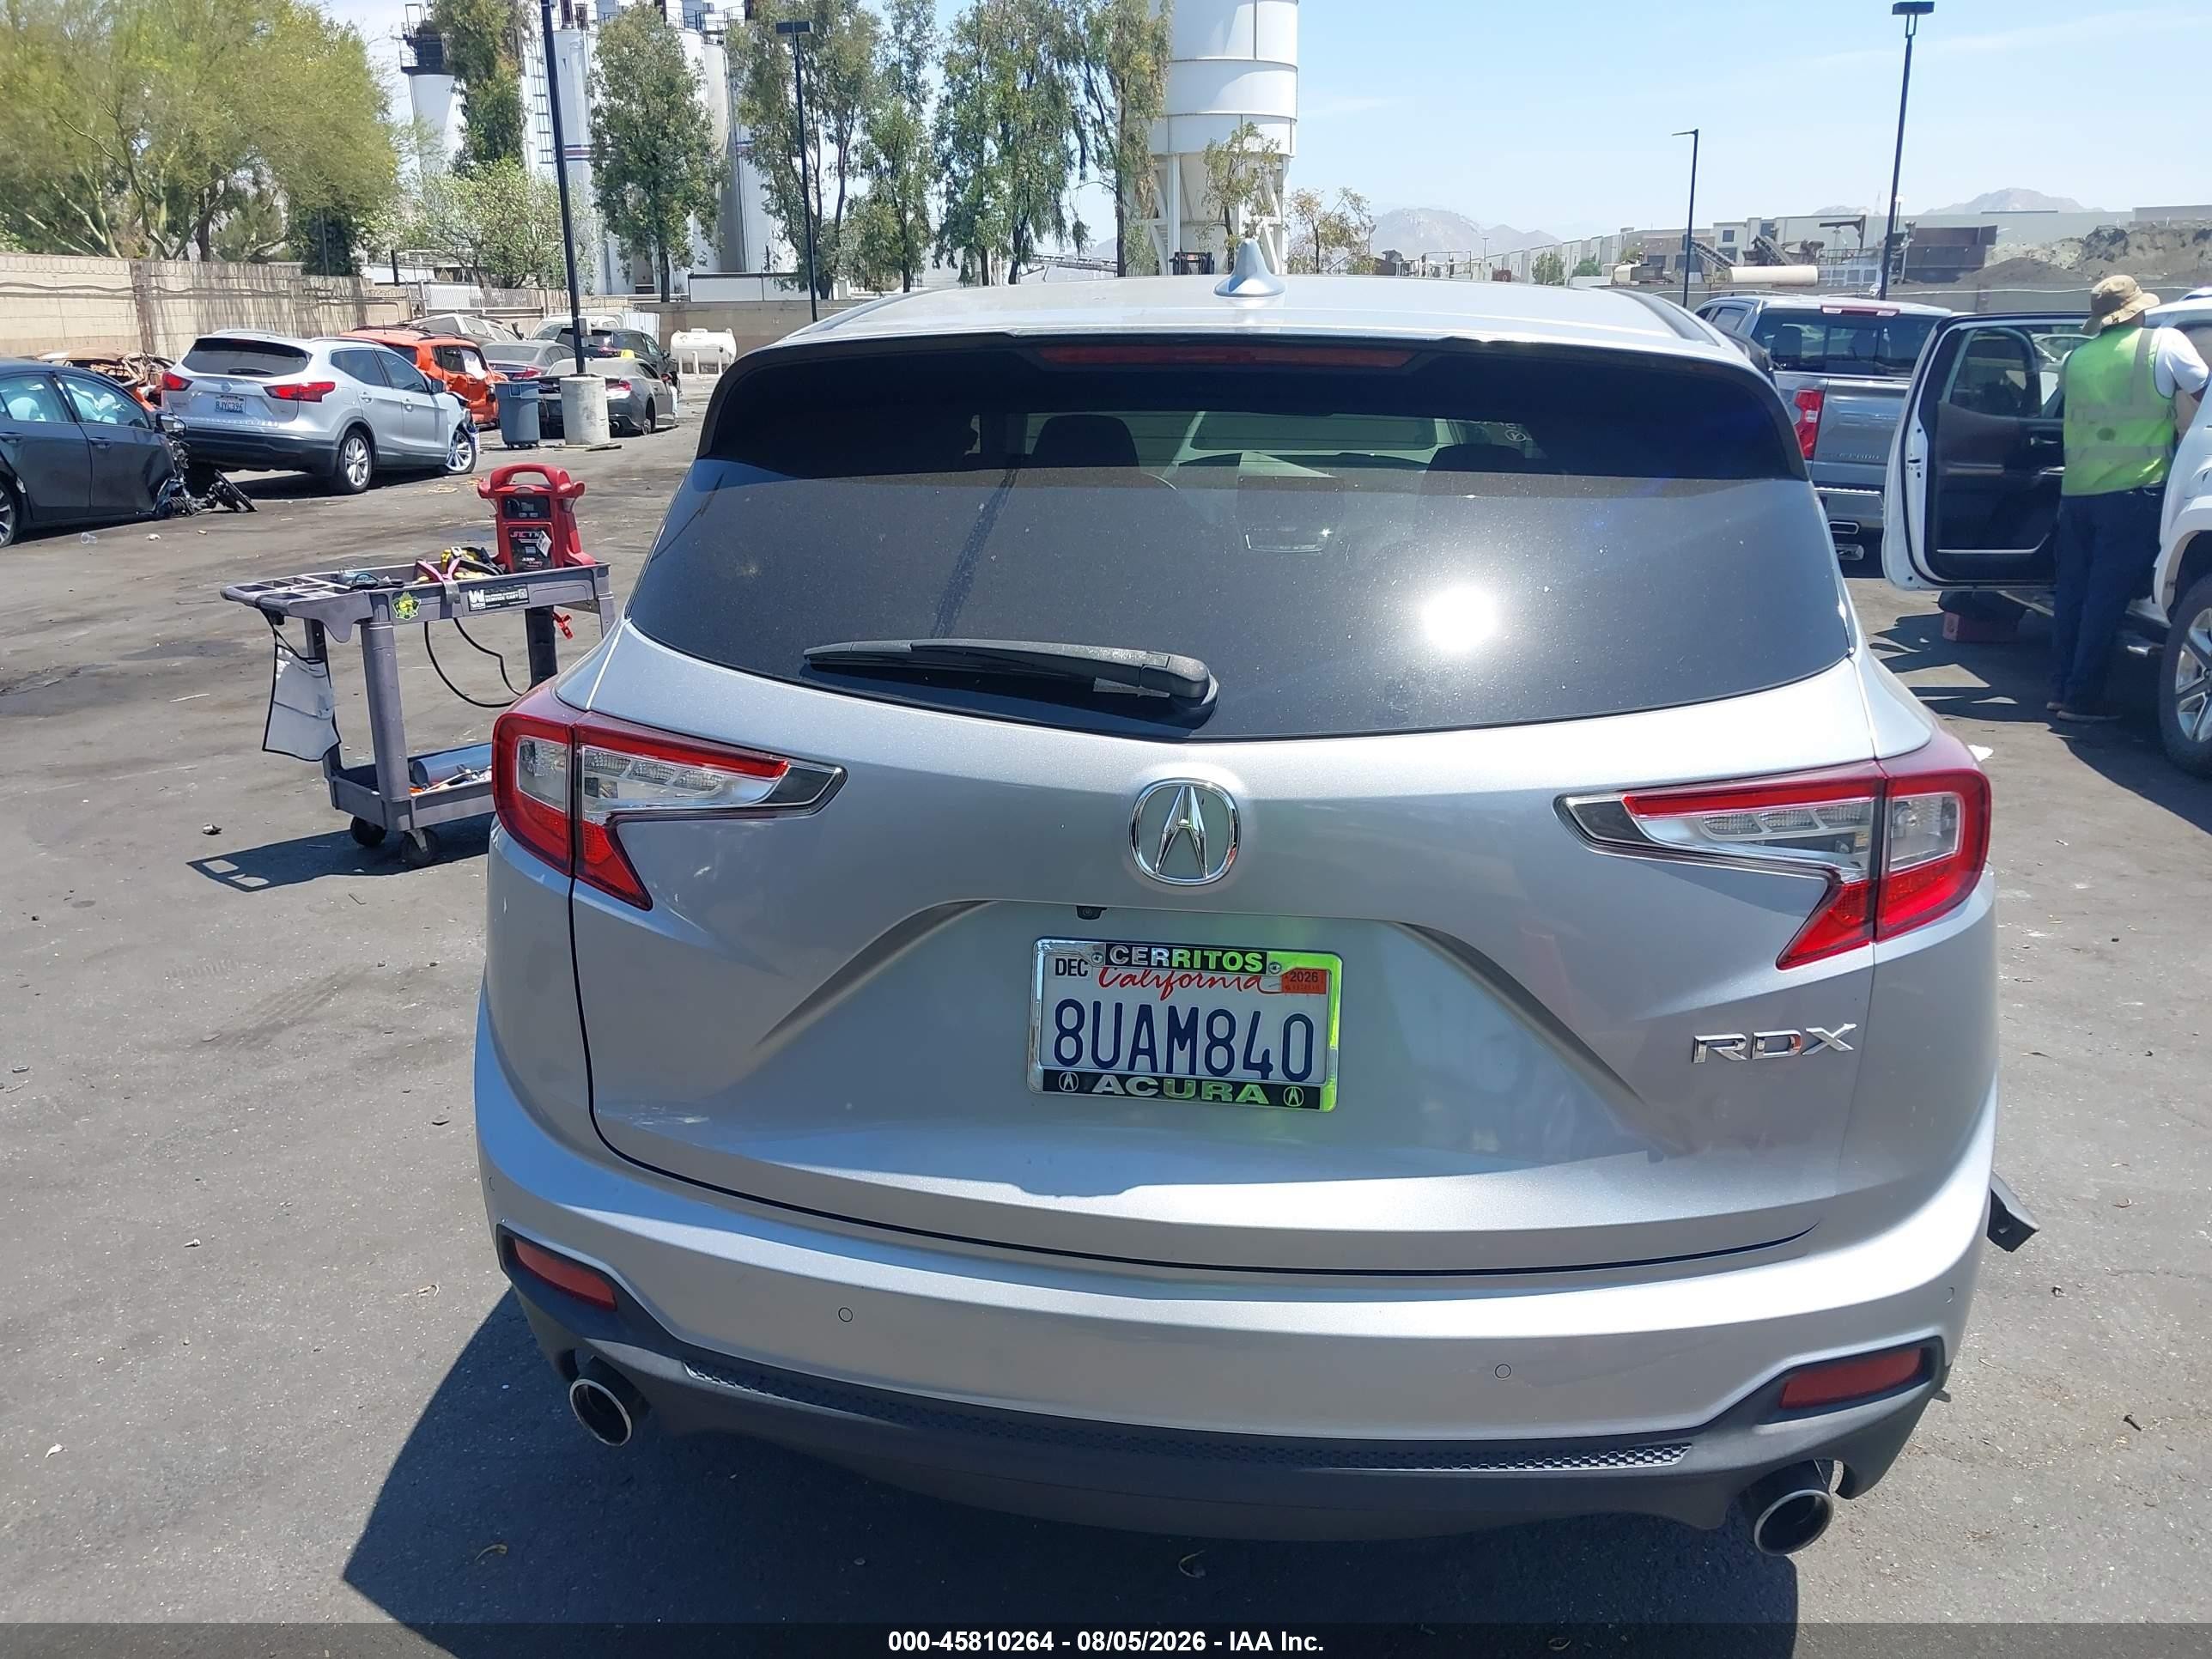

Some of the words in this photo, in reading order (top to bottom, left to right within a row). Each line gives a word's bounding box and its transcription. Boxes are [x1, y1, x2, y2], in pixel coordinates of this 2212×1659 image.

[1054, 957, 1088, 977] DEC
[1109, 946, 1263, 972] CERRITOS
[1098, 966, 1279, 1001] California
[1290, 971, 1319, 983] 2026
[1054, 999, 1314, 1083] 8UAM840
[1692, 1024, 1857, 1064] RDX
[1091, 1074, 1269, 1105] ACURA
